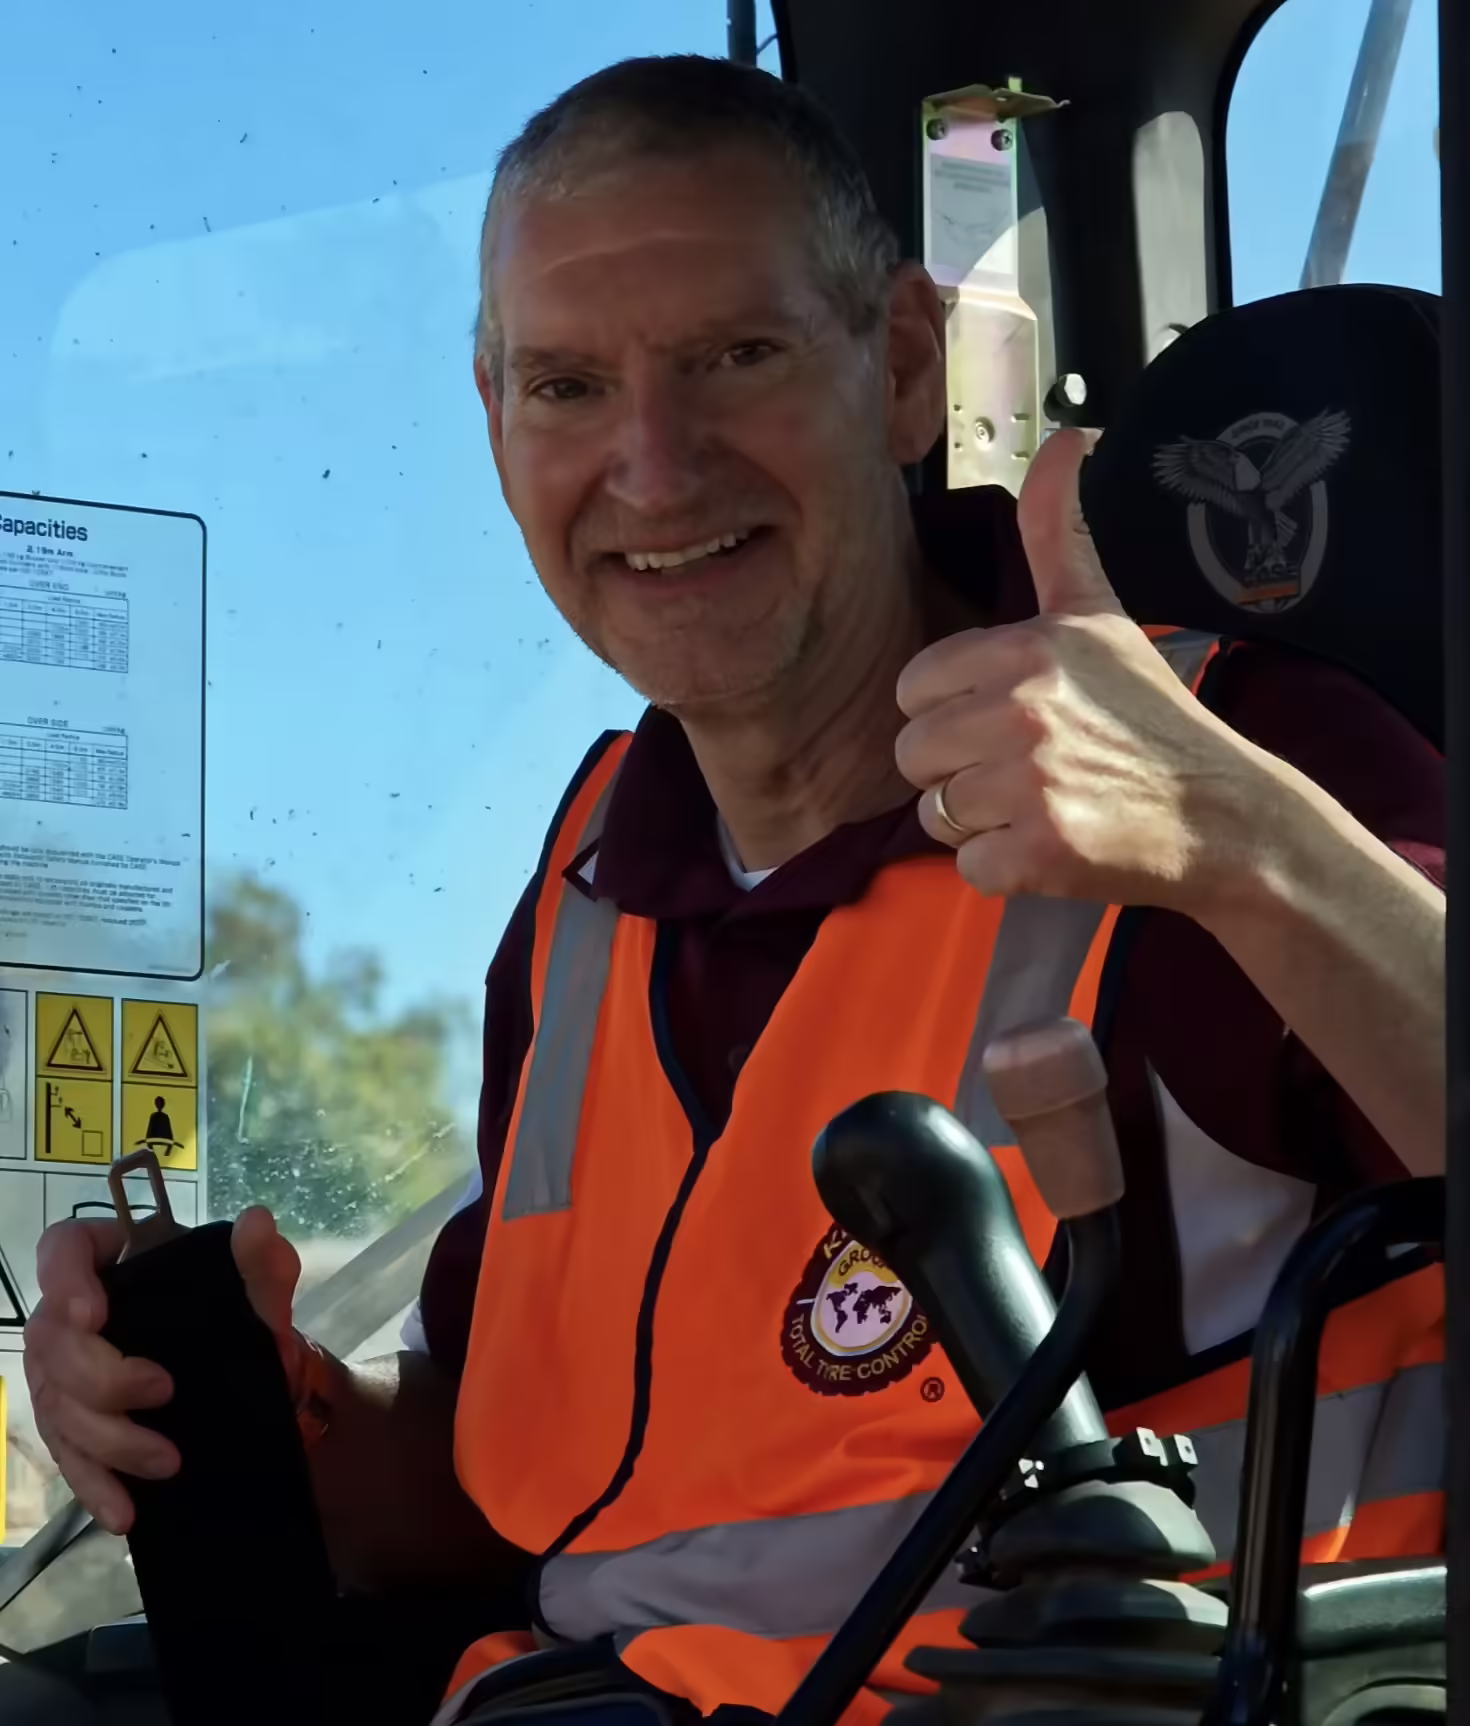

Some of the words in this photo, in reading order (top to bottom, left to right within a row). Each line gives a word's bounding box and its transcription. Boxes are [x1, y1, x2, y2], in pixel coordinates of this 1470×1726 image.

[0, 514, 88, 541] apacities
[838, 1247, 886, 1277] GROU
[789, 1313, 815, 1369] TOTAL
